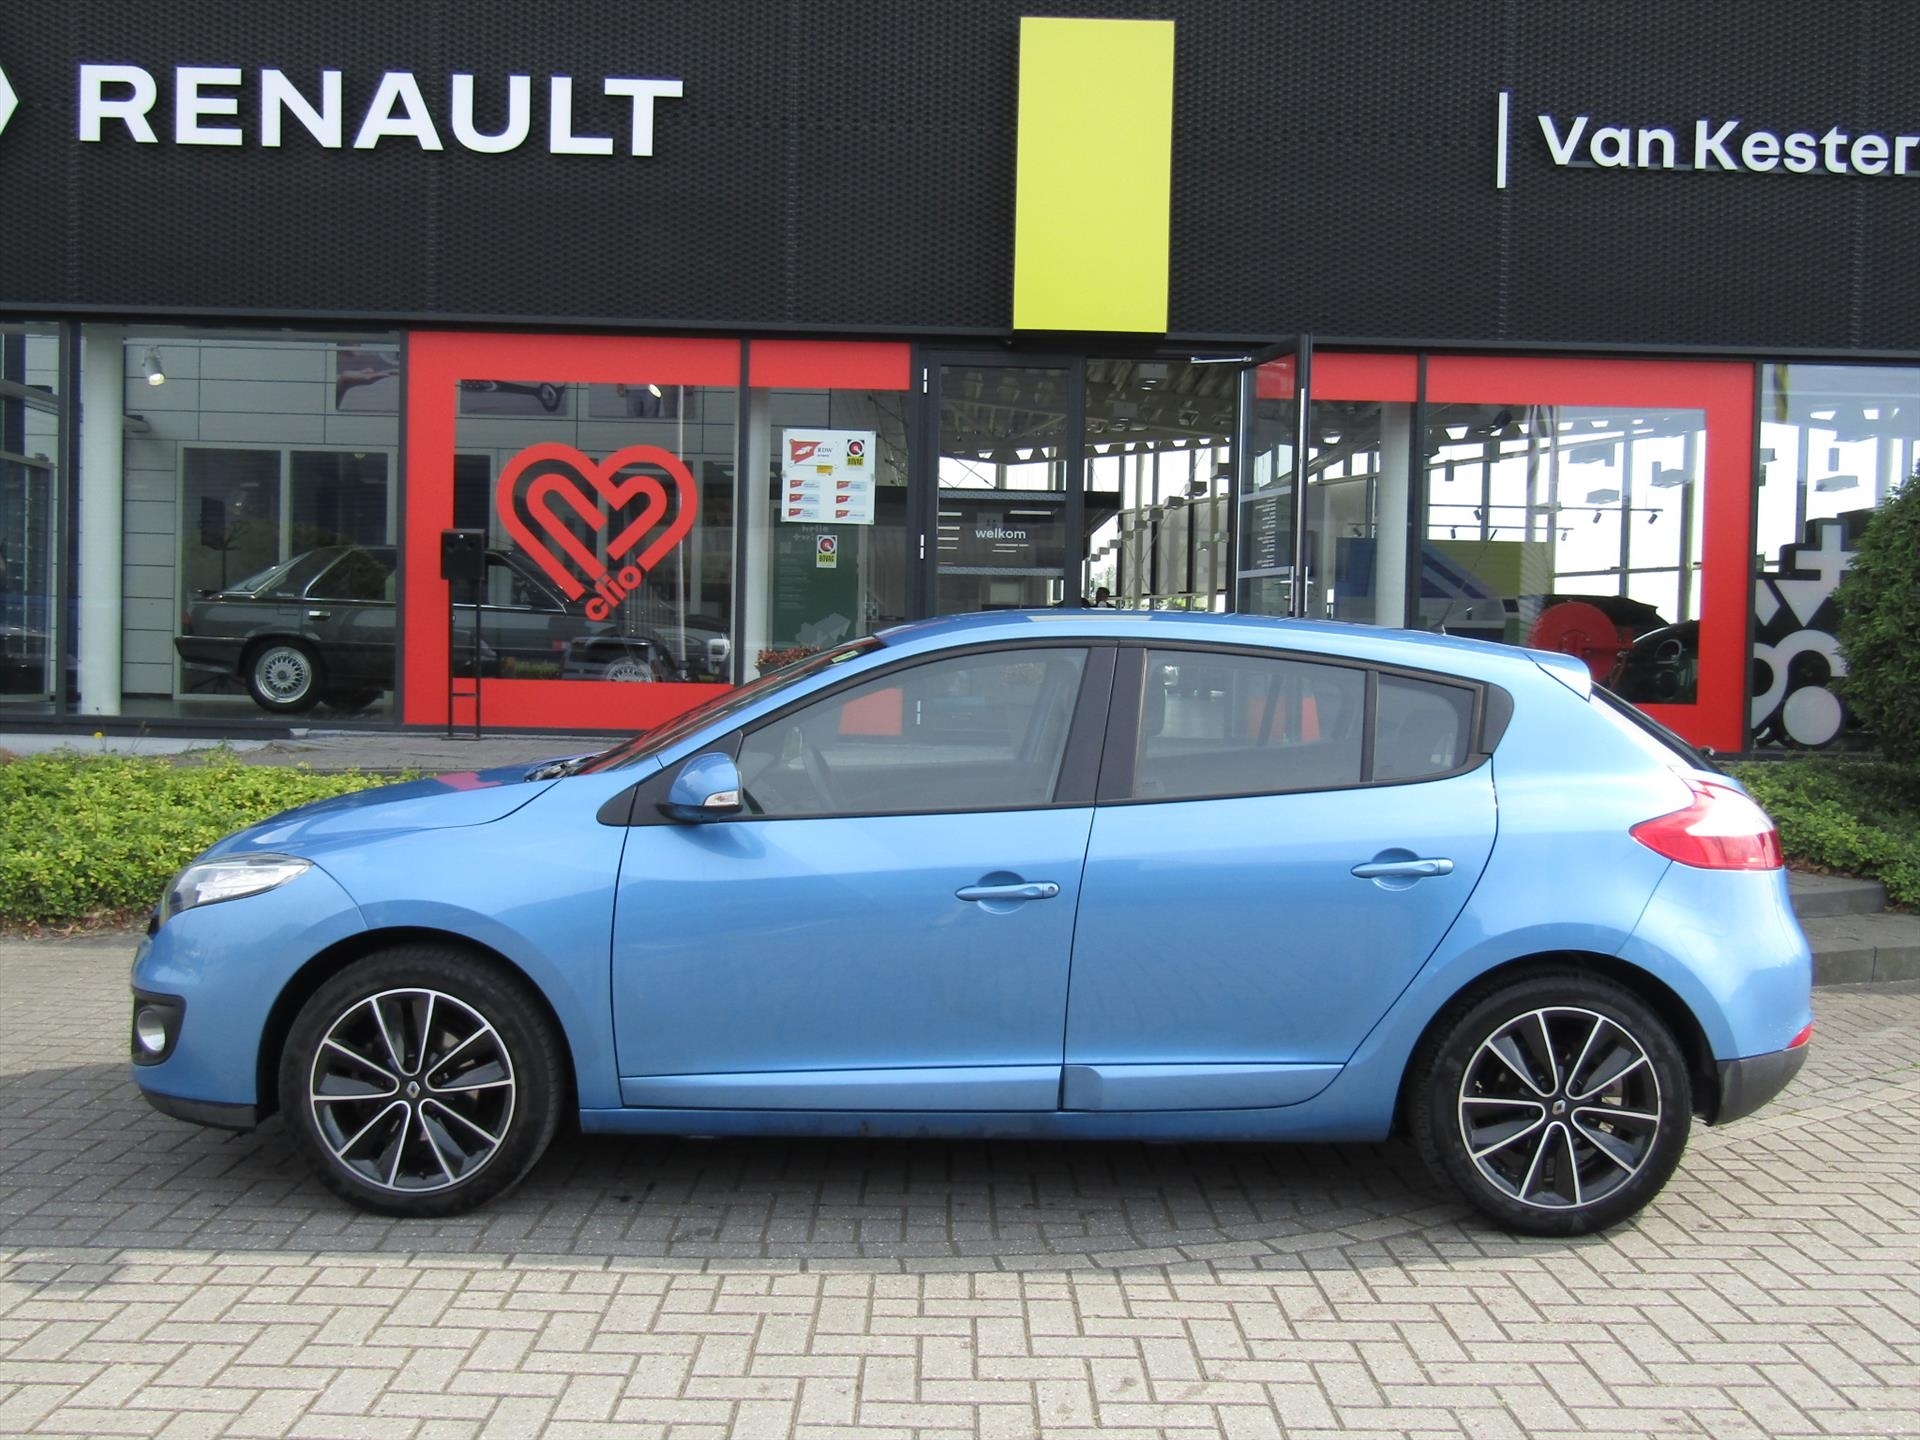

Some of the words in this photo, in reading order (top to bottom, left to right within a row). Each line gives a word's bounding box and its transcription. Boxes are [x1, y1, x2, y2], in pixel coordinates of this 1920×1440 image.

[79, 63, 684, 157] RENAULT
[1537, 115, 1675, 169] Van
[1694, 119, 1920, 175] Kester
[975, 528, 1026, 539] welkom
[585, 565, 642, 621] clio
